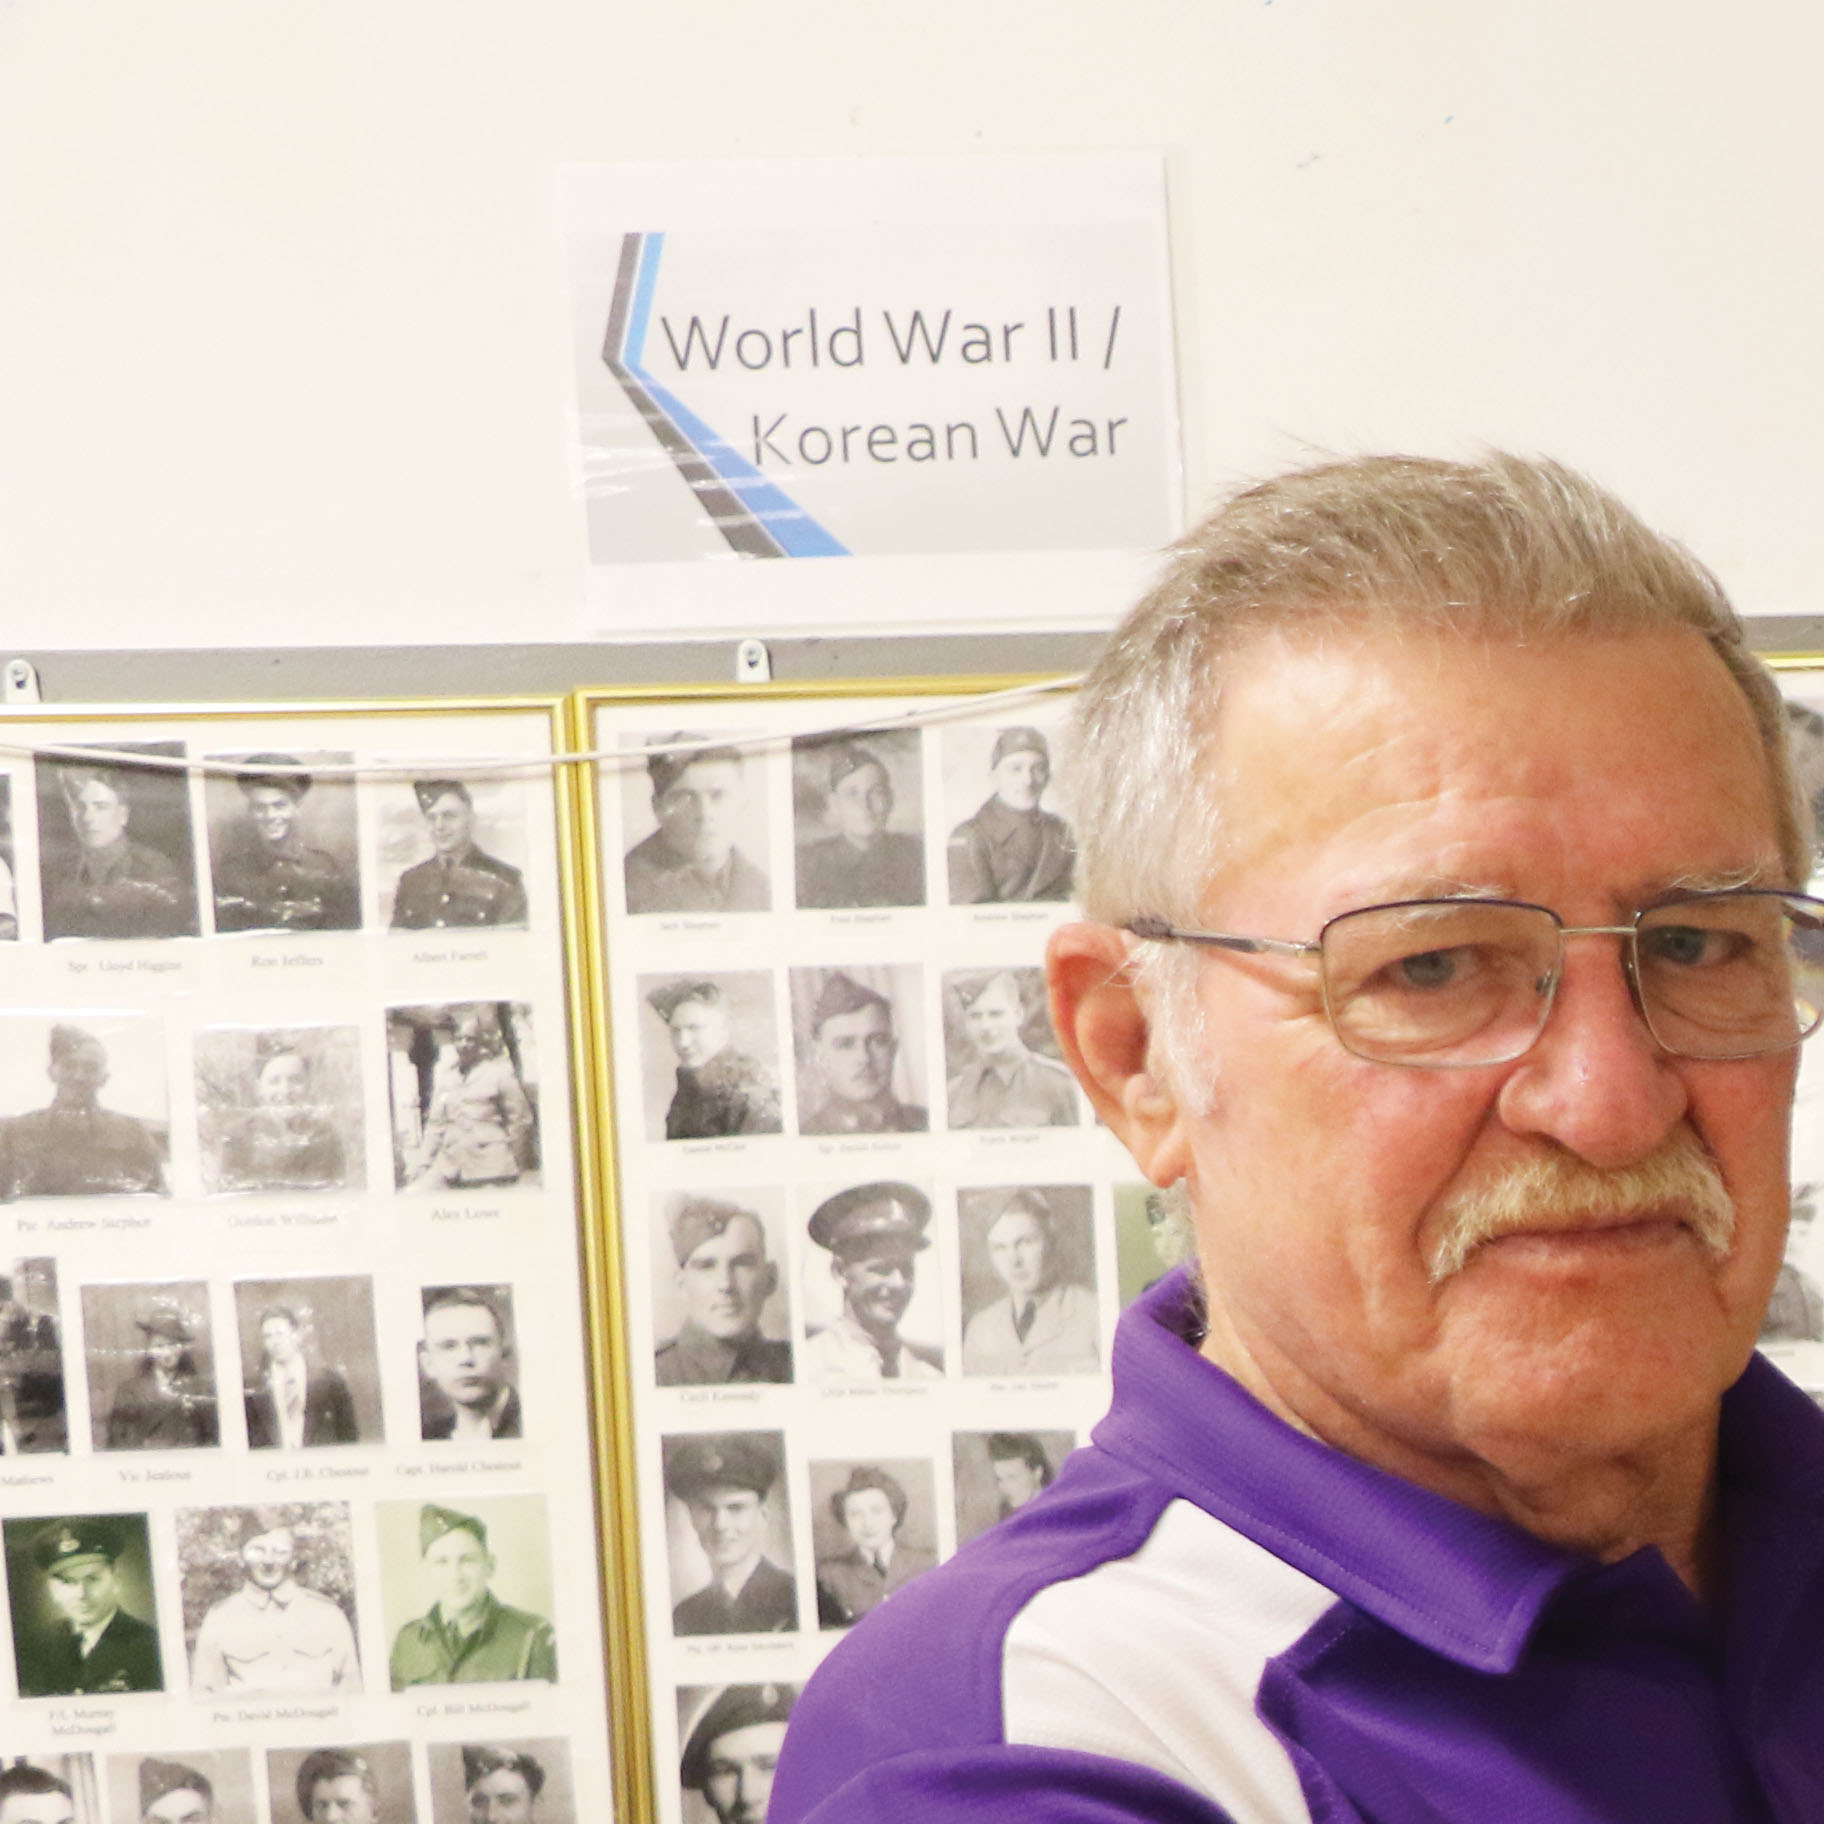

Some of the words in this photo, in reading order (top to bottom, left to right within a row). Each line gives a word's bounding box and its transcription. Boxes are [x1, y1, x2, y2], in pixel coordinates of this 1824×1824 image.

[660, 306, 865, 371] World
[882, 304, 1025, 366] War
[1046, 305, 1080, 362] II
[750, 412, 980, 467] Korean
[995, 405, 1129, 459] War
